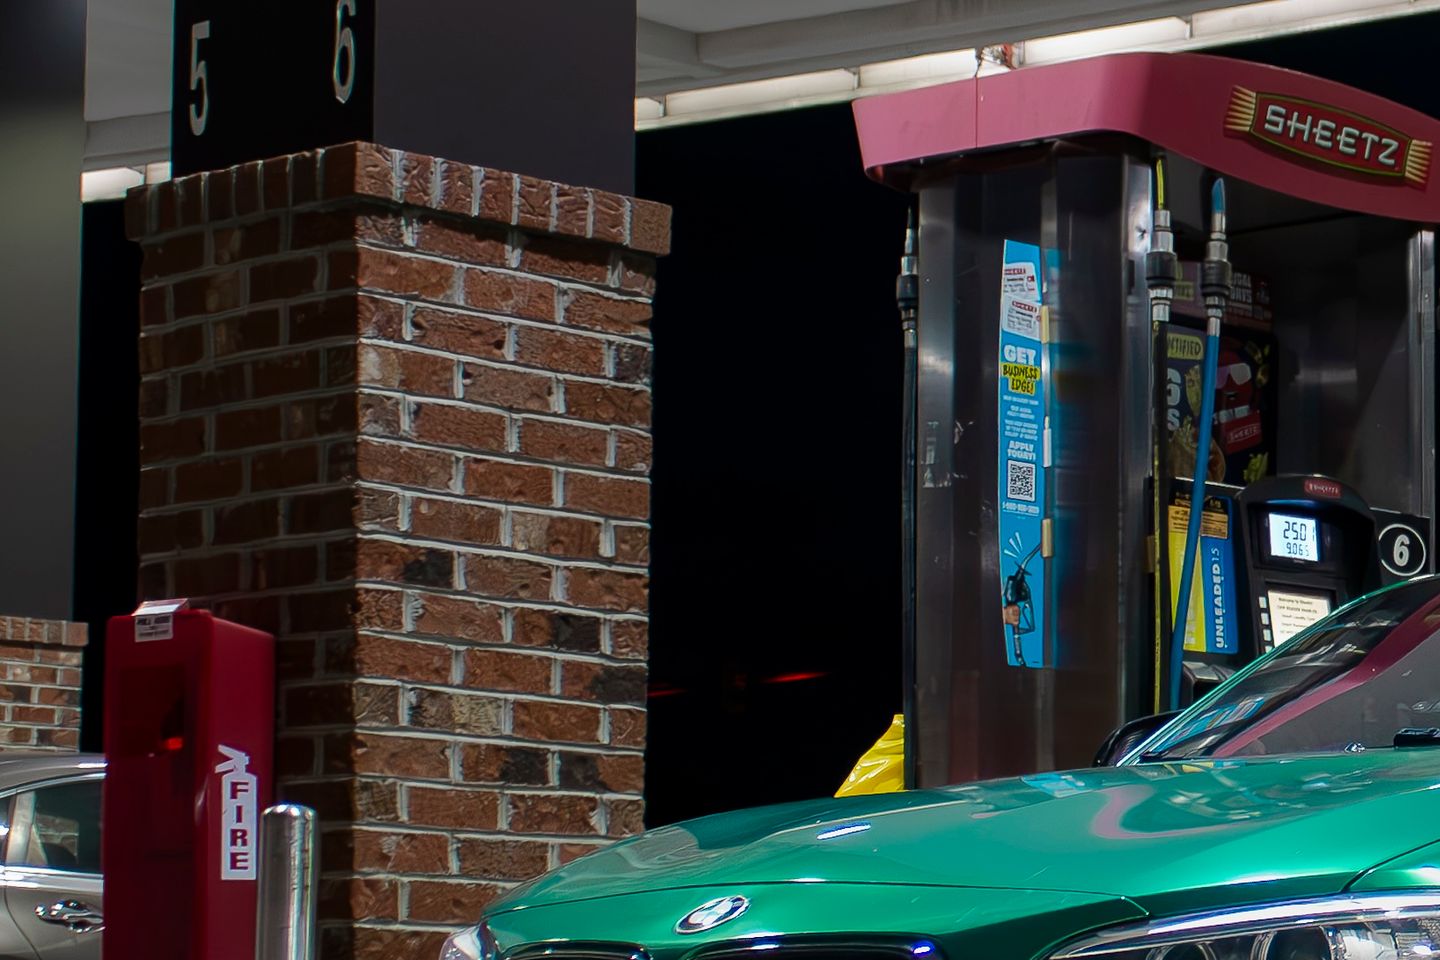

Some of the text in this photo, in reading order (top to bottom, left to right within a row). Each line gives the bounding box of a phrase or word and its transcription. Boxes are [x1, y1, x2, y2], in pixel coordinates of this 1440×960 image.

[333, 0, 356, 104] 6
[189, 20, 210, 136] 5
[1264, 104, 1399, 166] SHEETZ
[1004, 344, 1036, 366] GET
[1002, 364, 1038, 380] BUSINESS
[1011, 378, 1034, 395] EDGE!
[1007, 448, 1036, 462] TODAY!
[1009, 440, 1034, 452] APPLY
[1393, 534, 1410, 567] 6
[1211, 547, 1225, 649] UNLEADED 15
[230, 781, 249, 870] FIRE
